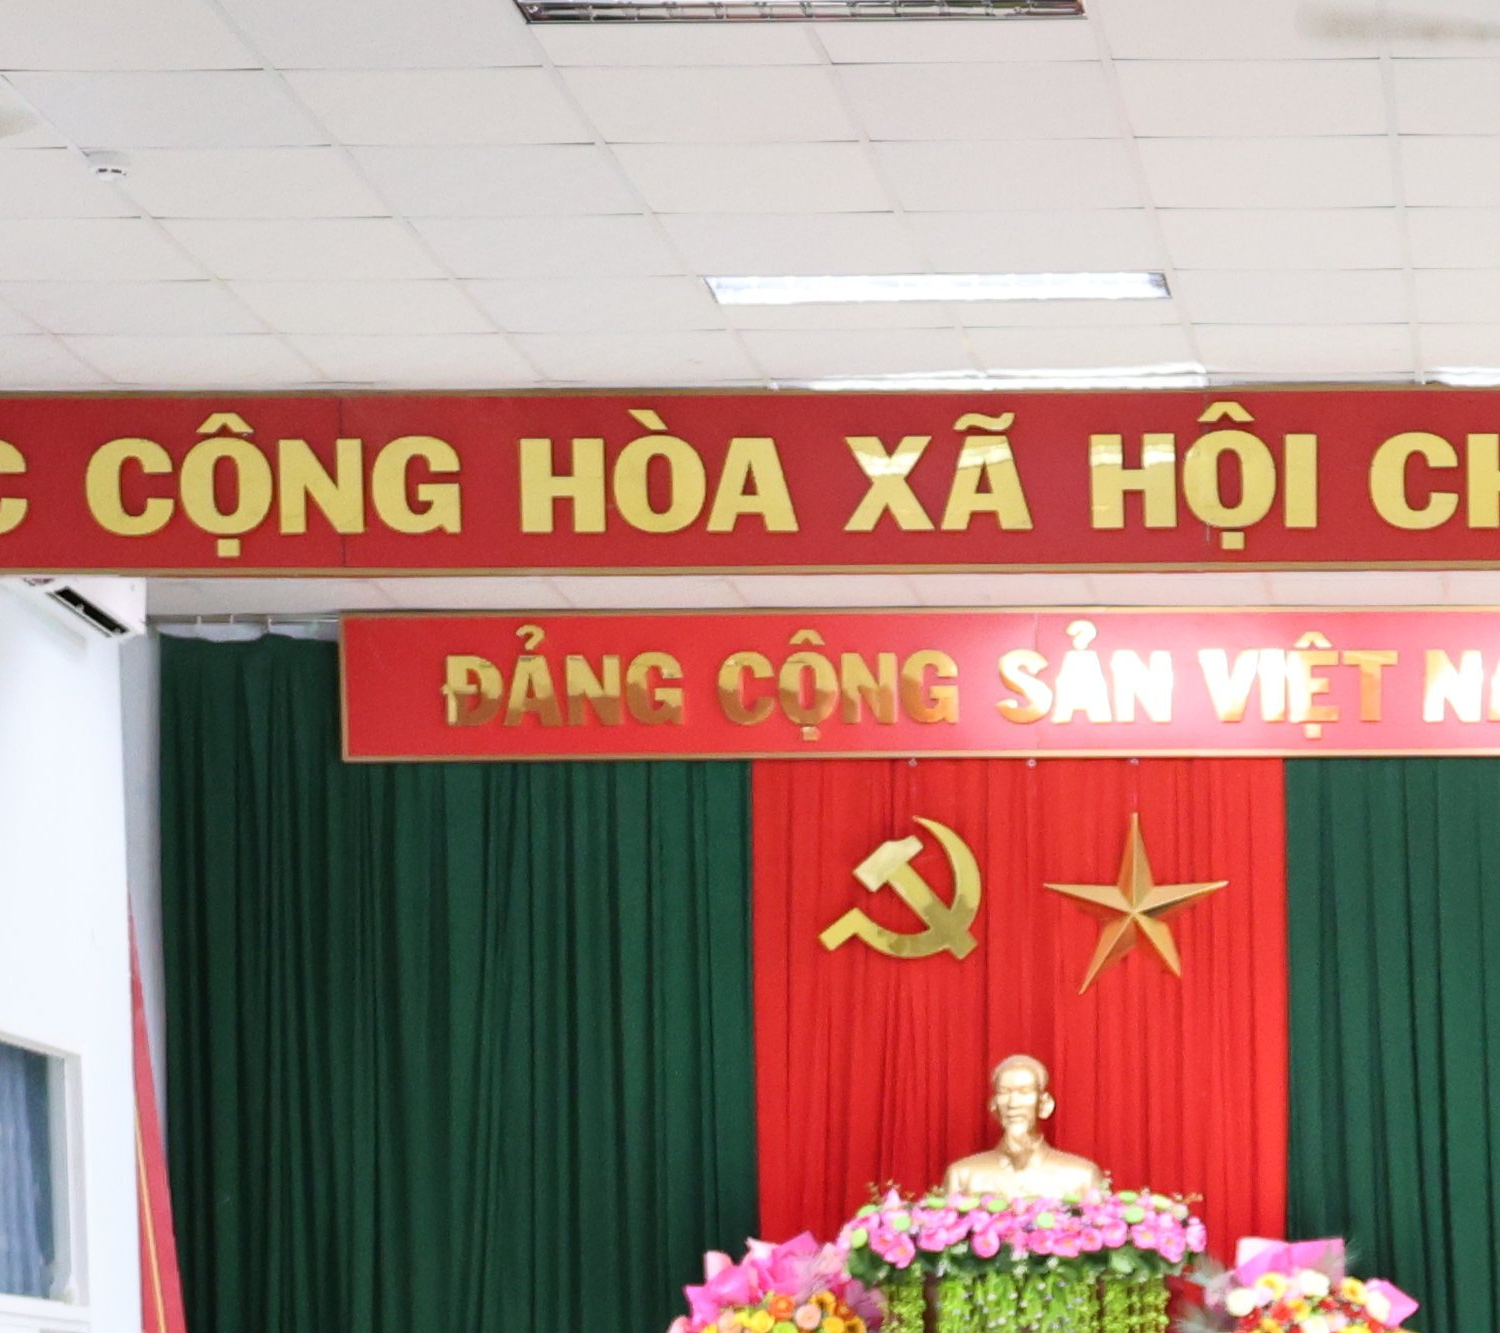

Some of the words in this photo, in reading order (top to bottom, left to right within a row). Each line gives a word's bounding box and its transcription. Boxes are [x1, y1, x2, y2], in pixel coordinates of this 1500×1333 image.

[85, 412, 461, 557] CỘNG
[519, 409, 799, 533] HÒA
[844, 412, 1033, 531] XÃ
[1088, 401, 1318, 550] HỘI
[441, 625, 683, 727] ĐẢNG
[717, 630, 959, 741] CỘNG
[997, 620, 1173, 723] SẢN
[1197, 631, 1398, 739] VIỆT
